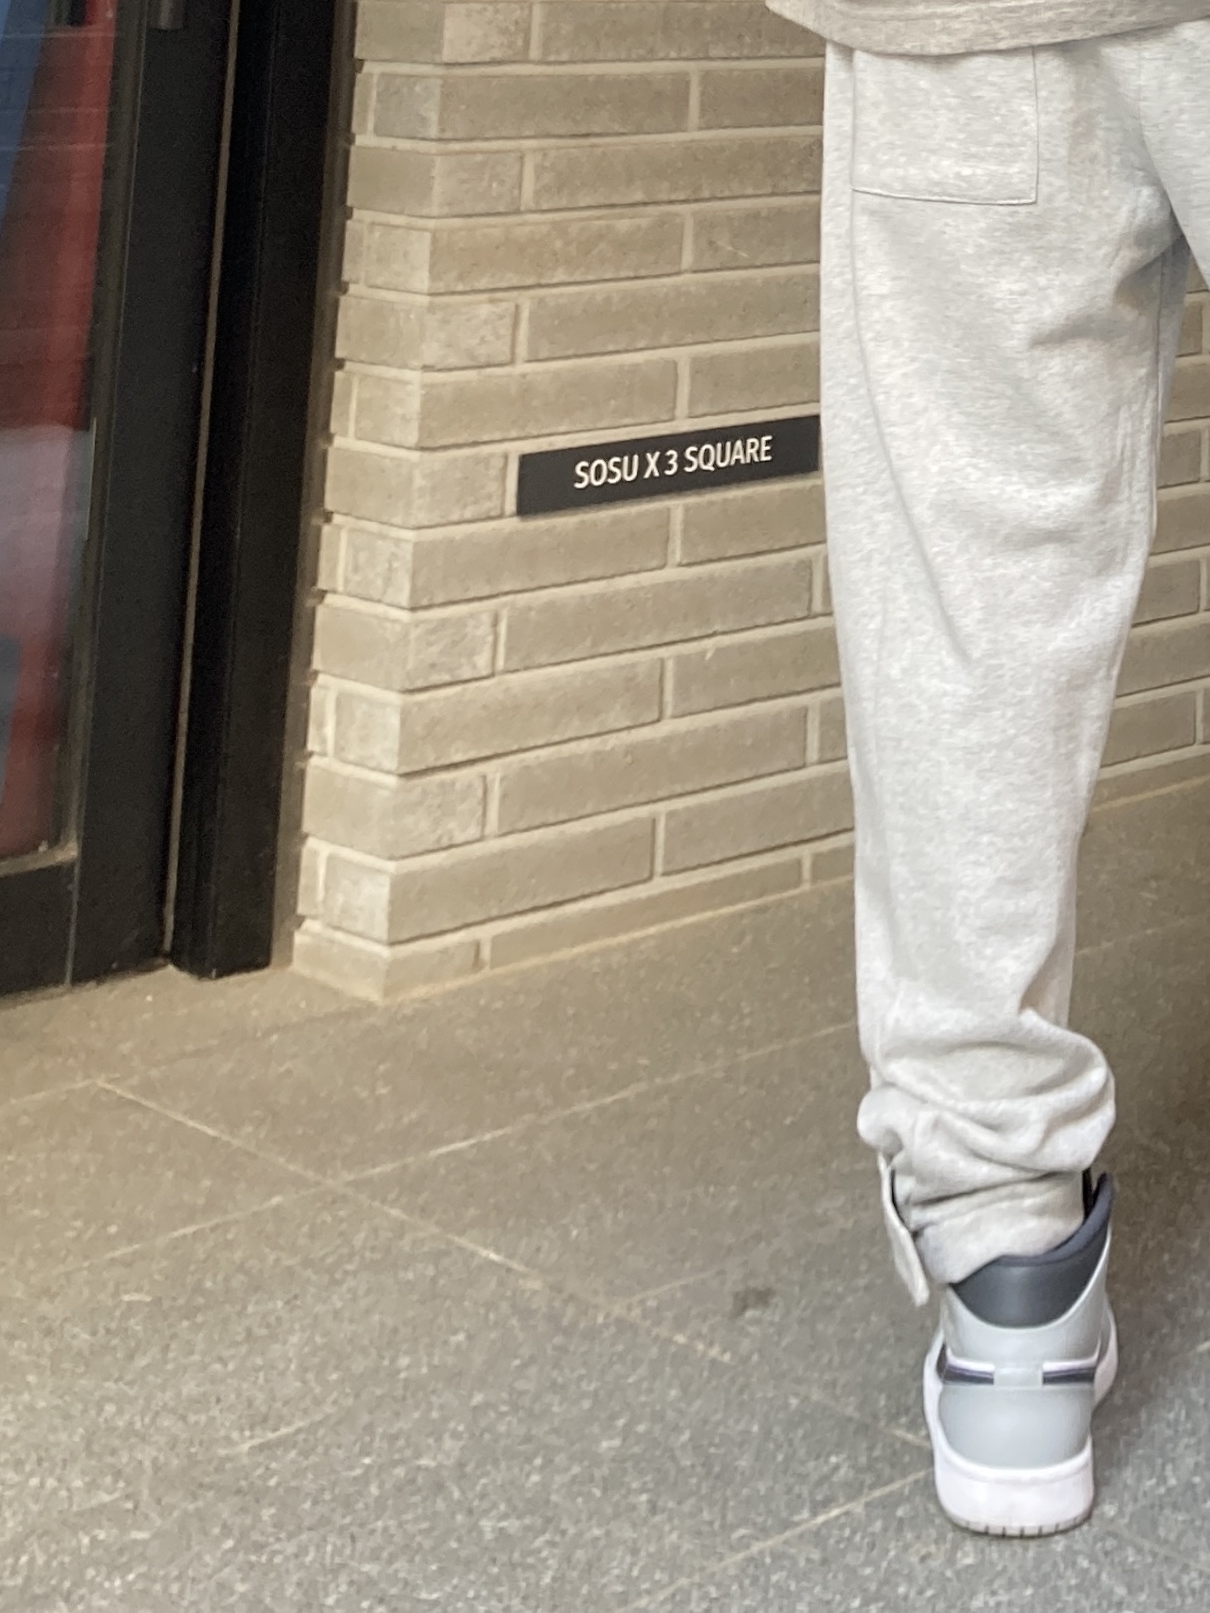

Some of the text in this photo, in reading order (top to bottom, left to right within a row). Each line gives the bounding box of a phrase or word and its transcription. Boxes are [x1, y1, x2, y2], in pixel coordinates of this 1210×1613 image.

[573, 435, 774, 490] SOSU X 3 SQUARE
